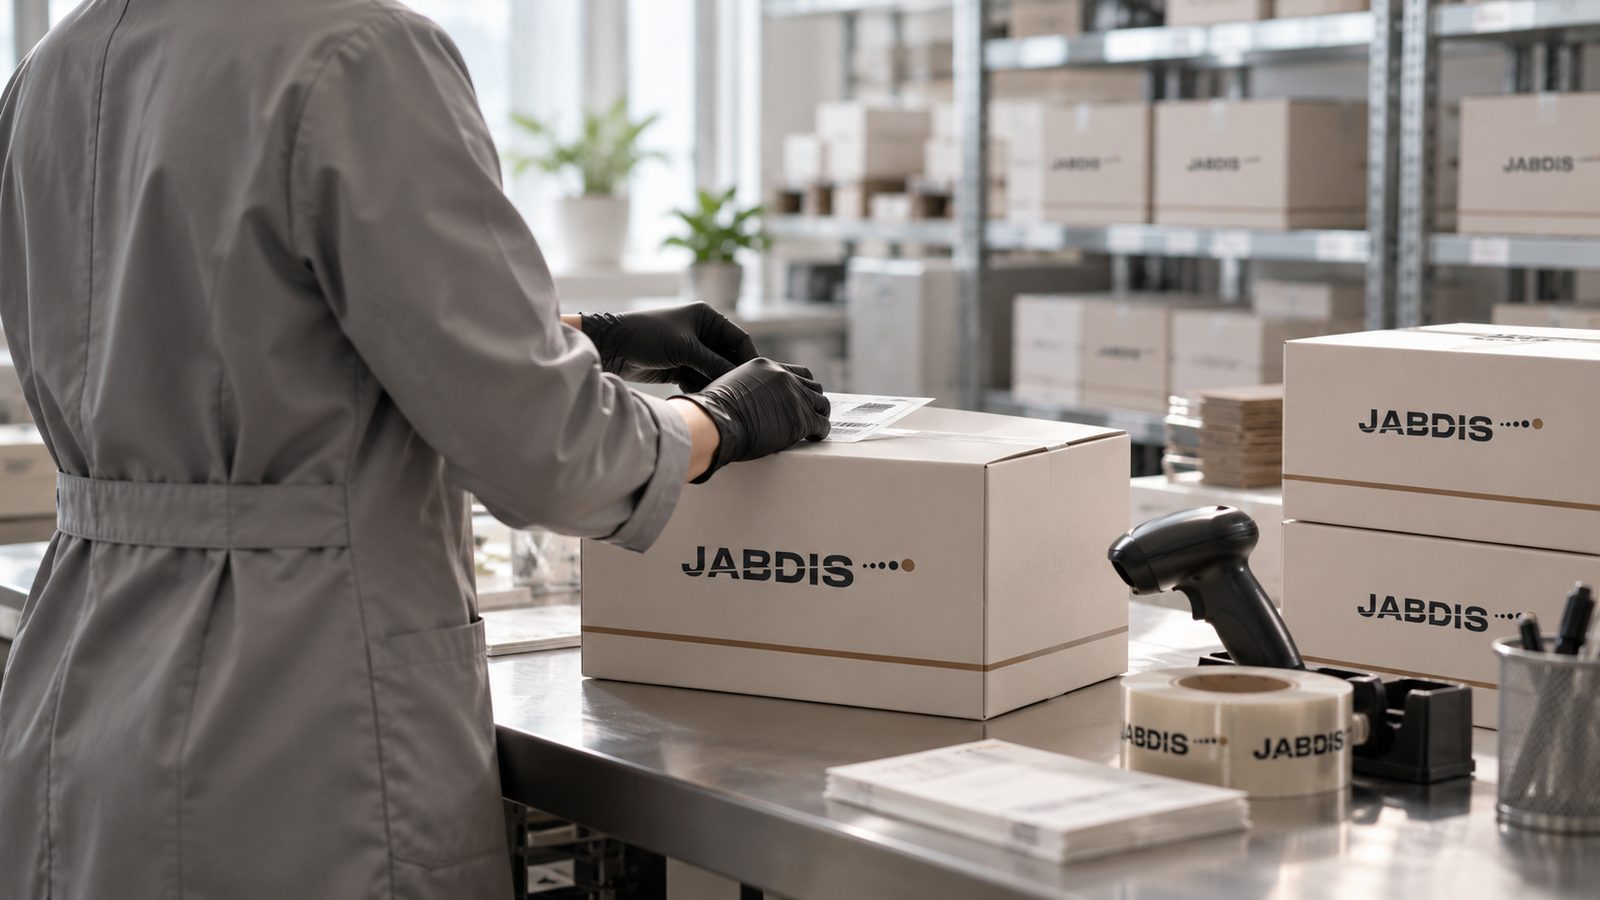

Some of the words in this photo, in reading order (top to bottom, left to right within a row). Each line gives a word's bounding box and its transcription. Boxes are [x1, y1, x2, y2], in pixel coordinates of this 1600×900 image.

[1502, 156, 1575, 173] JABDIS
[1358, 409, 1493, 442] JABDIS
[681, 546, 854, 588] JABDIS
[1357, 593, 1489, 632] JABDIS
[1252, 730, 1344, 760] JABDIS
